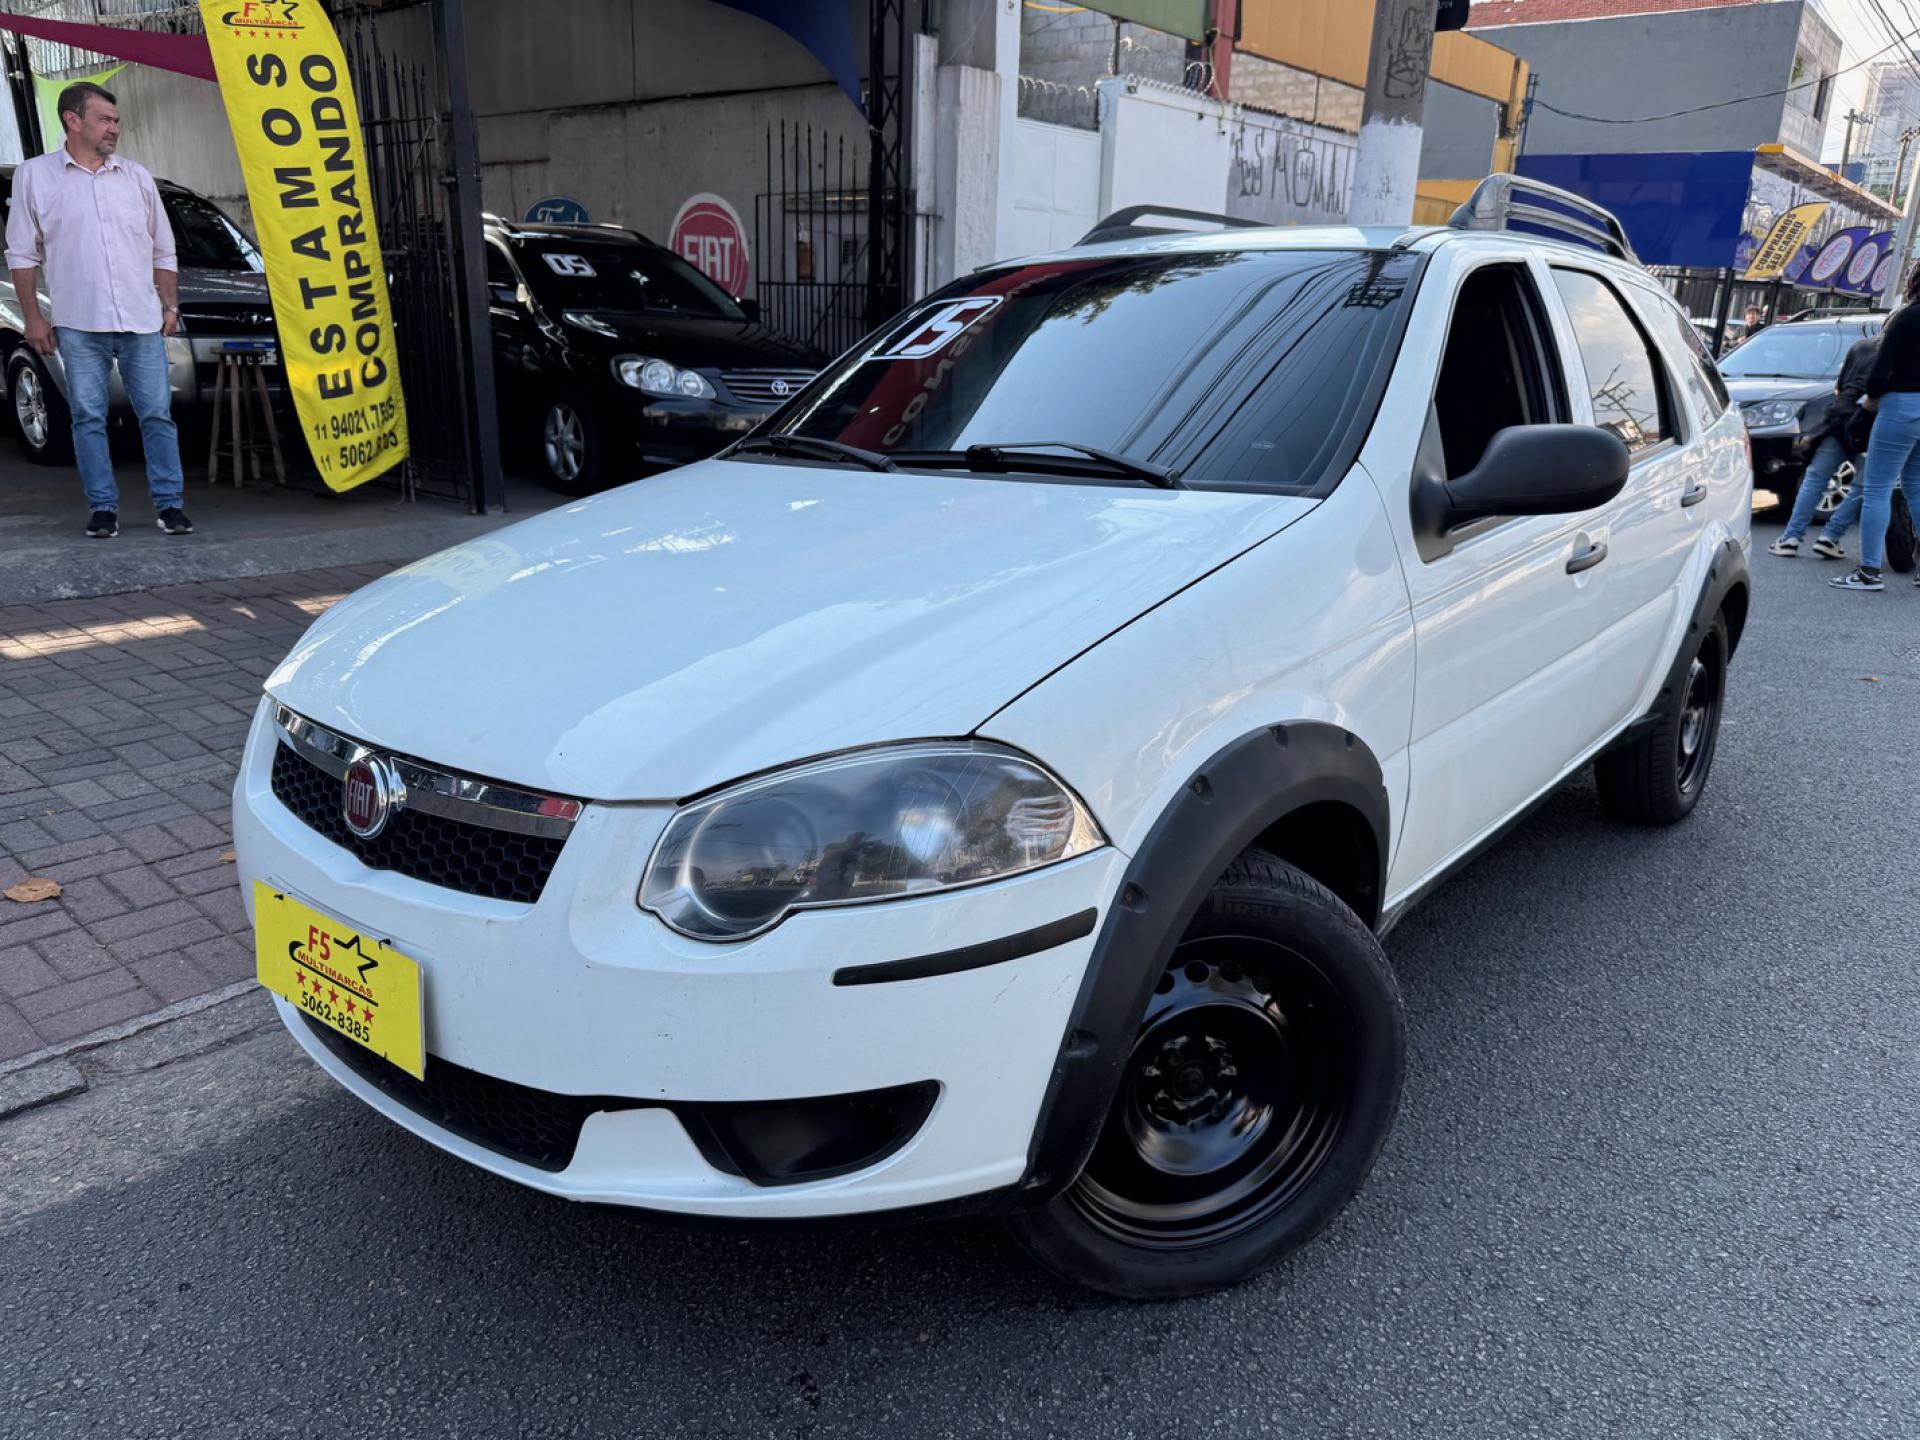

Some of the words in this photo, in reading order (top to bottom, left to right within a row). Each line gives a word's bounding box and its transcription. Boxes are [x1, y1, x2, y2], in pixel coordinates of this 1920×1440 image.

[242, 2, 272, 20] F5
[246, 53, 354, 400] ESTAMOS
[300, 54, 388, 389] COMPRANDO
[1754, 213, 1797, 270] COMPRAMOS
[546, 255, 594, 275] 05
[683, 235, 735, 282] FIAT
[886, 298, 994, 355] 15
[314, 423, 328, 440] 11
[348, 777, 374, 819] FIAT
[307, 924, 331, 961] F5
[298, 950, 374, 998] MULTIMARCAS
[301, 990, 370, 1043] 5062-8385
